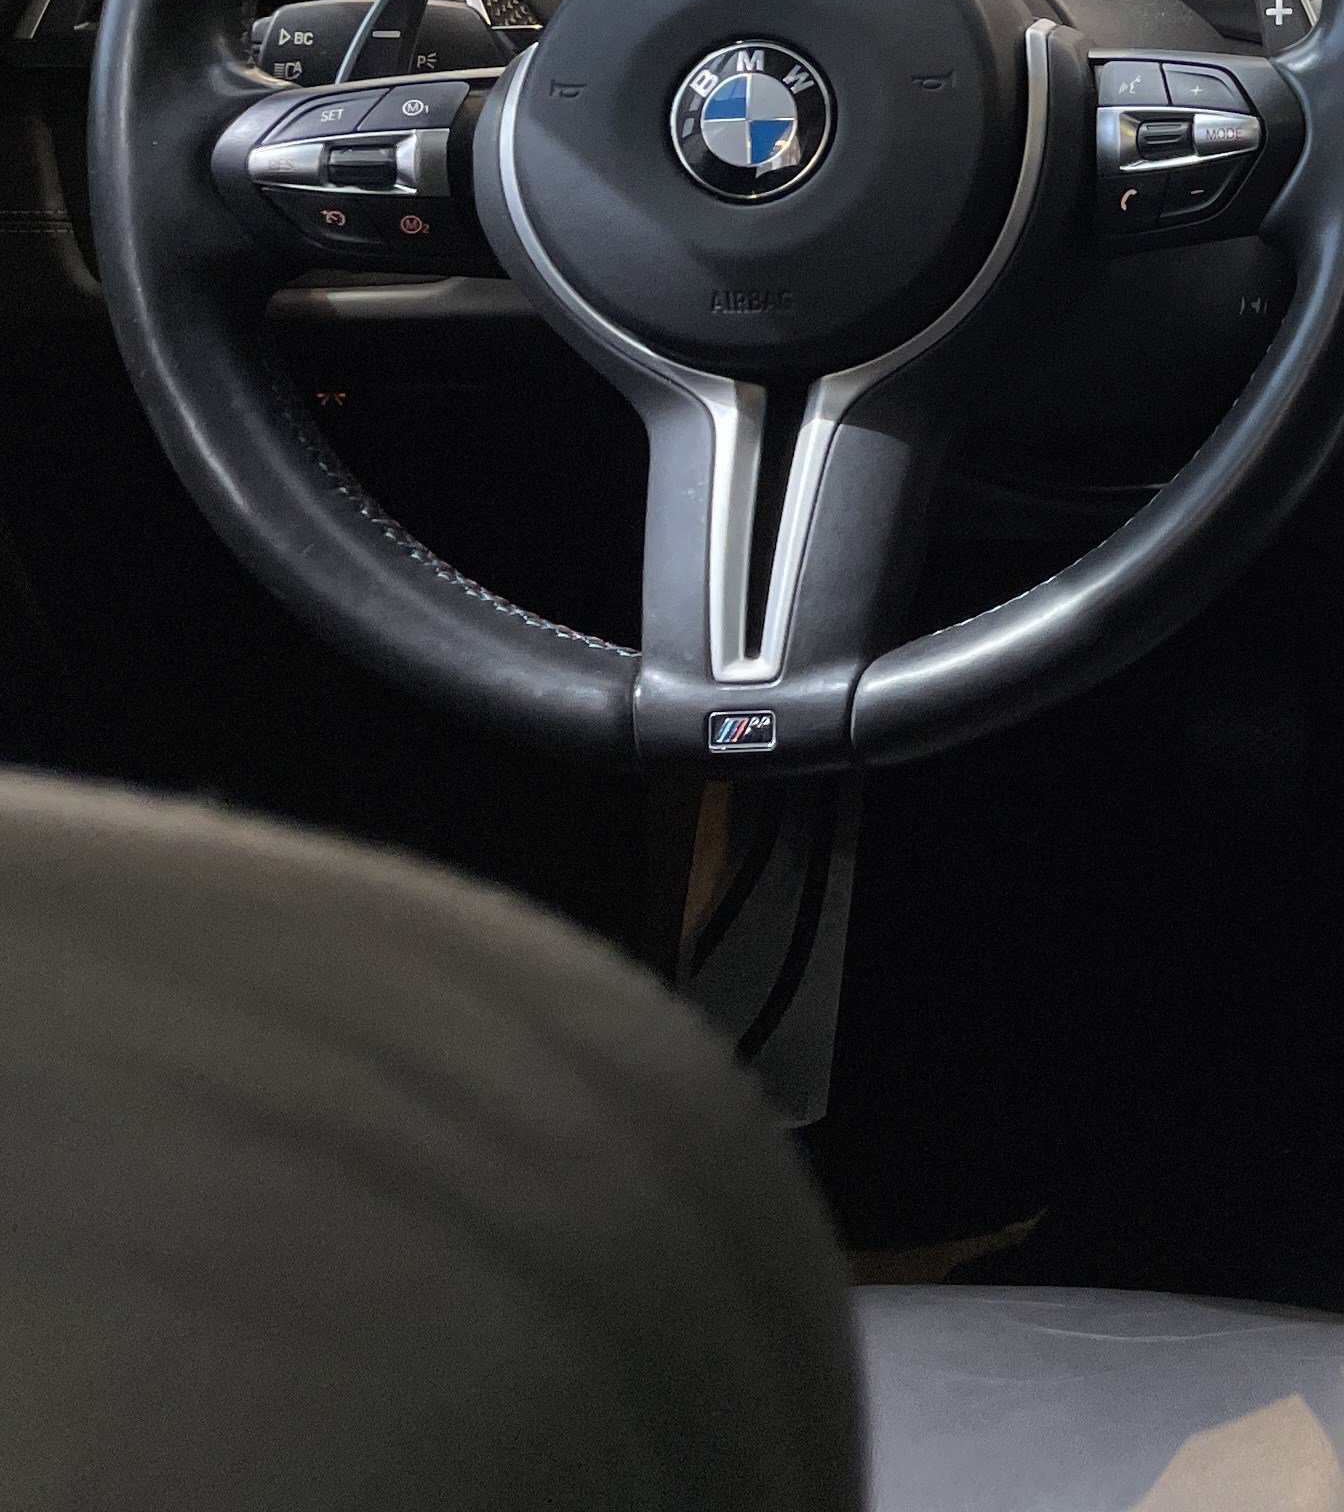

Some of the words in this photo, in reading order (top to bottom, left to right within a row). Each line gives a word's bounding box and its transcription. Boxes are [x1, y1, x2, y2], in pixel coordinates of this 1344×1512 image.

[294, 32, 314, 45] BC
[689, 49, 815, 98] BMW
[321, 109, 345, 122] SET
[1205, 127, 1243, 142] MODE
